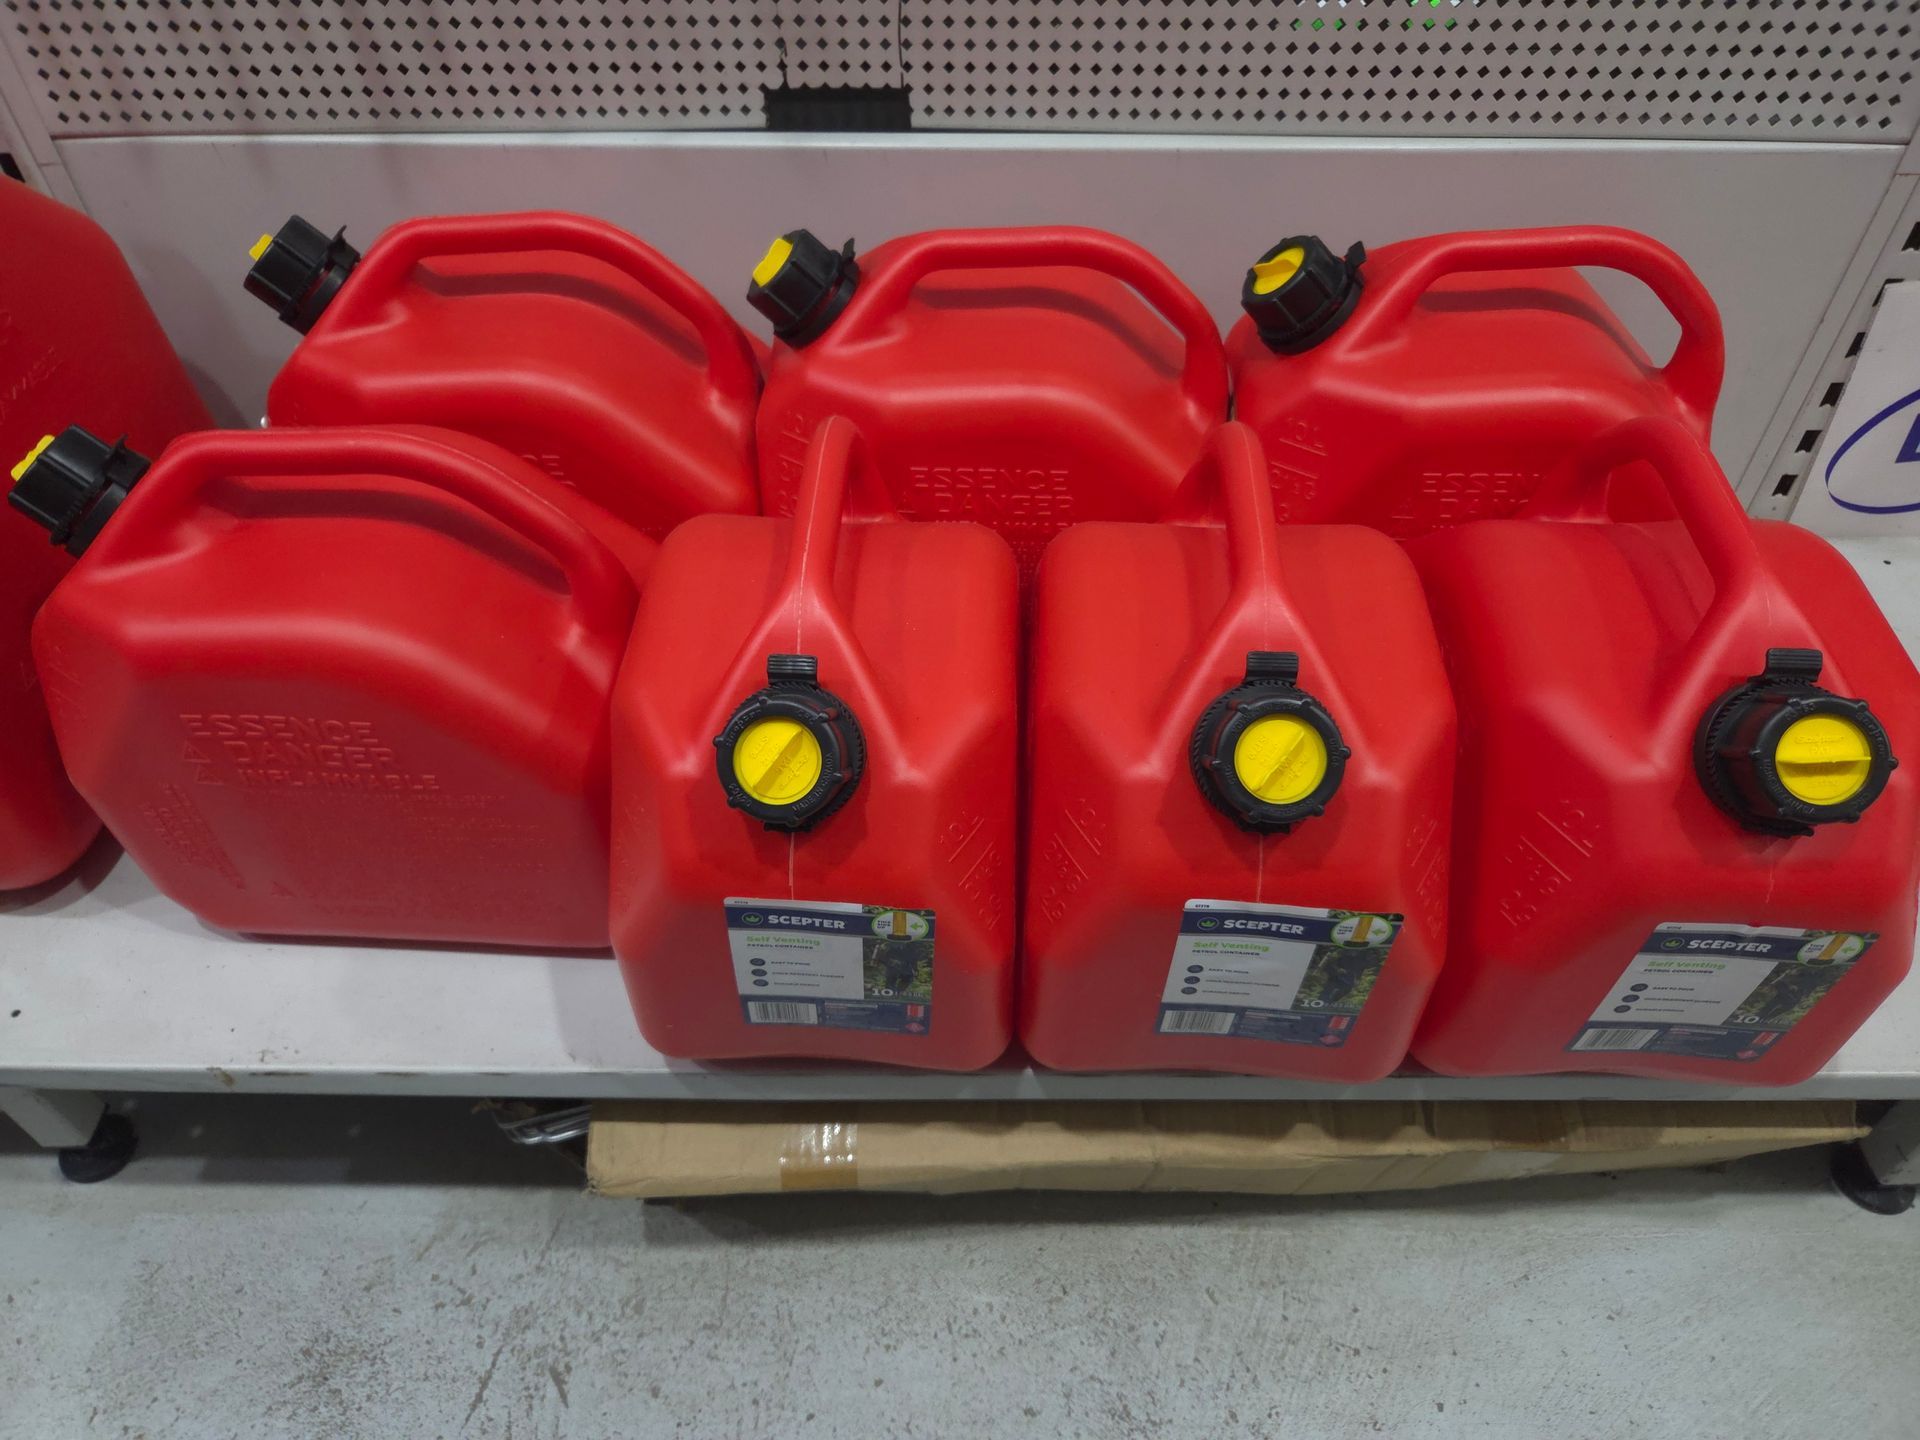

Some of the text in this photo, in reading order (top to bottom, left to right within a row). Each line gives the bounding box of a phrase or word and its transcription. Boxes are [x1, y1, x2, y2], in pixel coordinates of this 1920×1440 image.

[910, 467, 1069, 491] ESSENCE
[1423, 472, 1541, 493] ESSEN
[934, 493, 1075, 516] DANGER
[180, 713, 379, 744] ESSENCE
[222, 740, 397, 769] DANGER
[235, 767, 441, 791] INFLAMMABLE
[768, 914, 846, 930] SCEPTER
[1223, 919, 1305, 936] SCEPTER
[745, 935, 820, 948] Self Venting
[1193, 941, 1270, 952] Self Venting
[1687, 939, 1773, 954] SCEPTER
[1647, 960, 1727, 970] Self Venting
[872, 987, 893, 997] 10
[1301, 999, 1325, 1009] 10
[1733, 1015, 1759, 1025] 10
